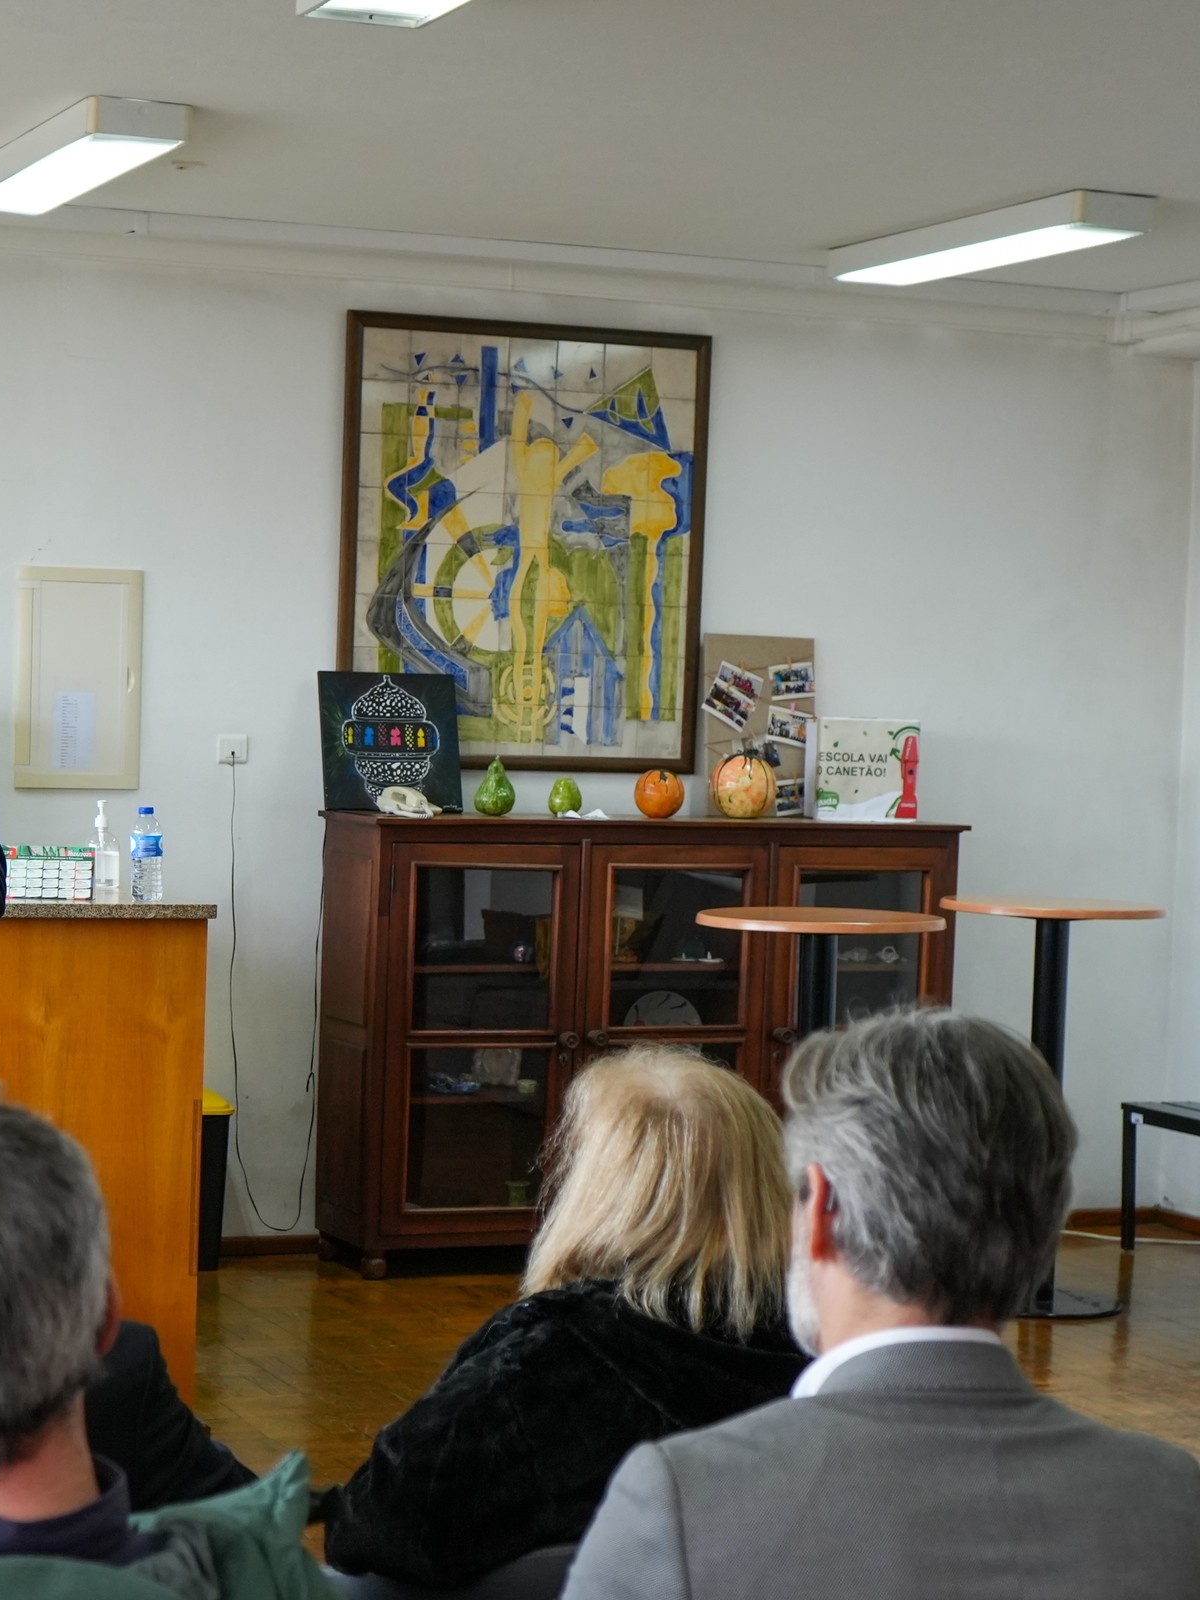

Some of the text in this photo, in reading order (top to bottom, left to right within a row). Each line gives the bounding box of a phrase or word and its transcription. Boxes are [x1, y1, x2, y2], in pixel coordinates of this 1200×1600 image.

[819, 752, 888, 764] ESCOLA VAI
[826, 765, 887, 778] CANETÃO!
